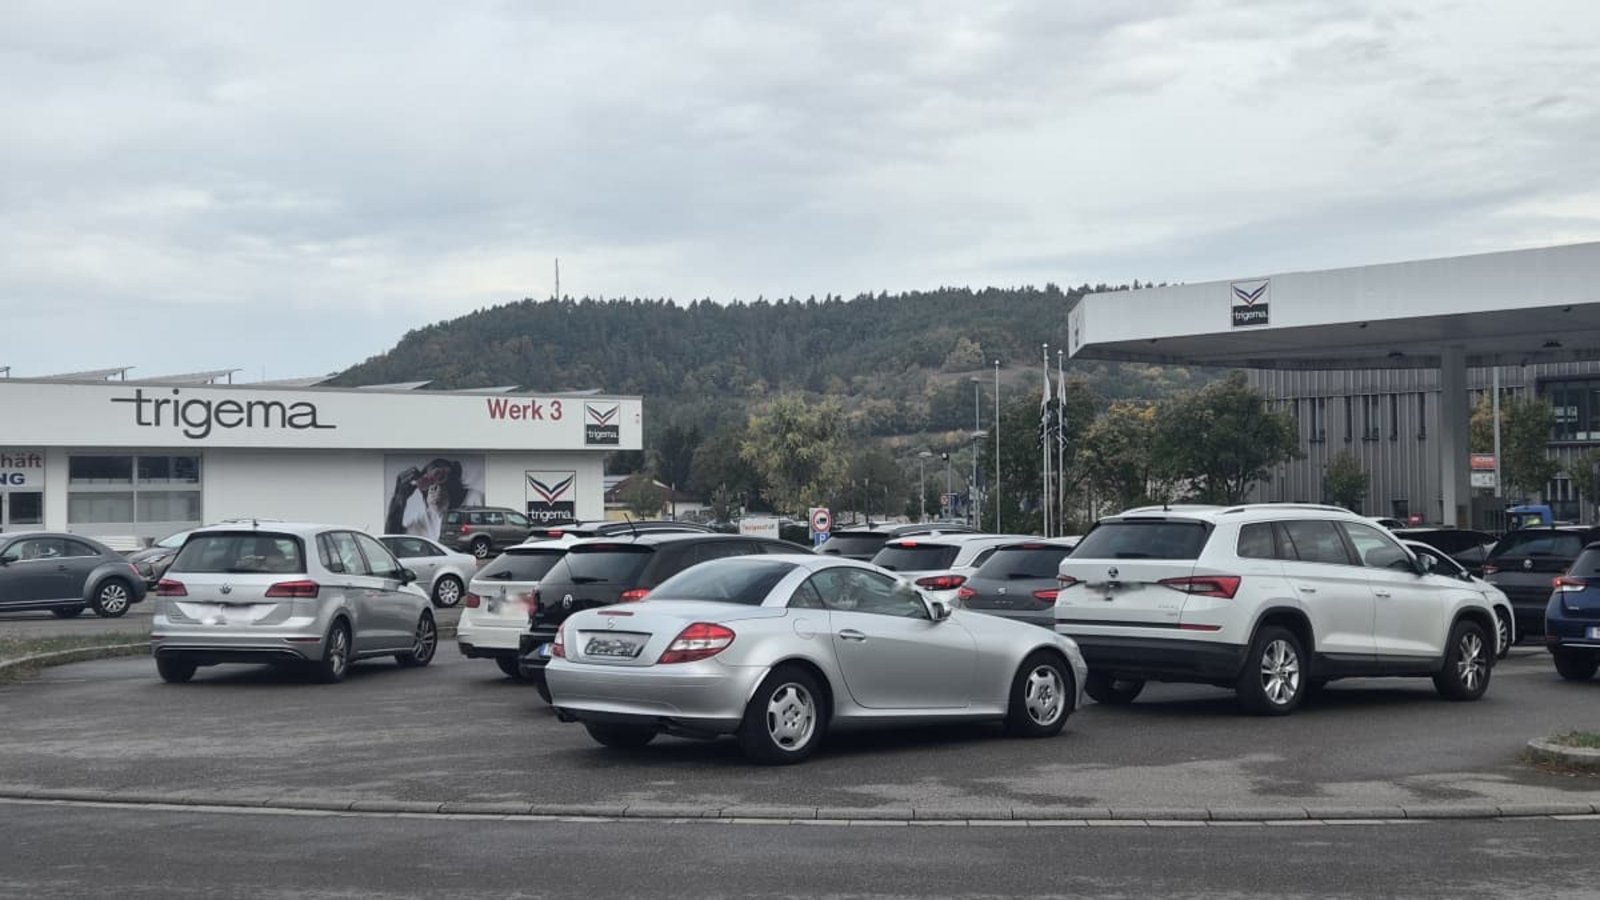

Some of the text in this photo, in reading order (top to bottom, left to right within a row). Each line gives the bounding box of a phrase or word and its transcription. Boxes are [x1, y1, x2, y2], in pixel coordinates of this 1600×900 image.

[110, 388, 337, 439] trigema
[486, 398, 563, 421] Werk 3
[586, 428, 619, 440] trigema
[526, 507, 575, 523] trigema
